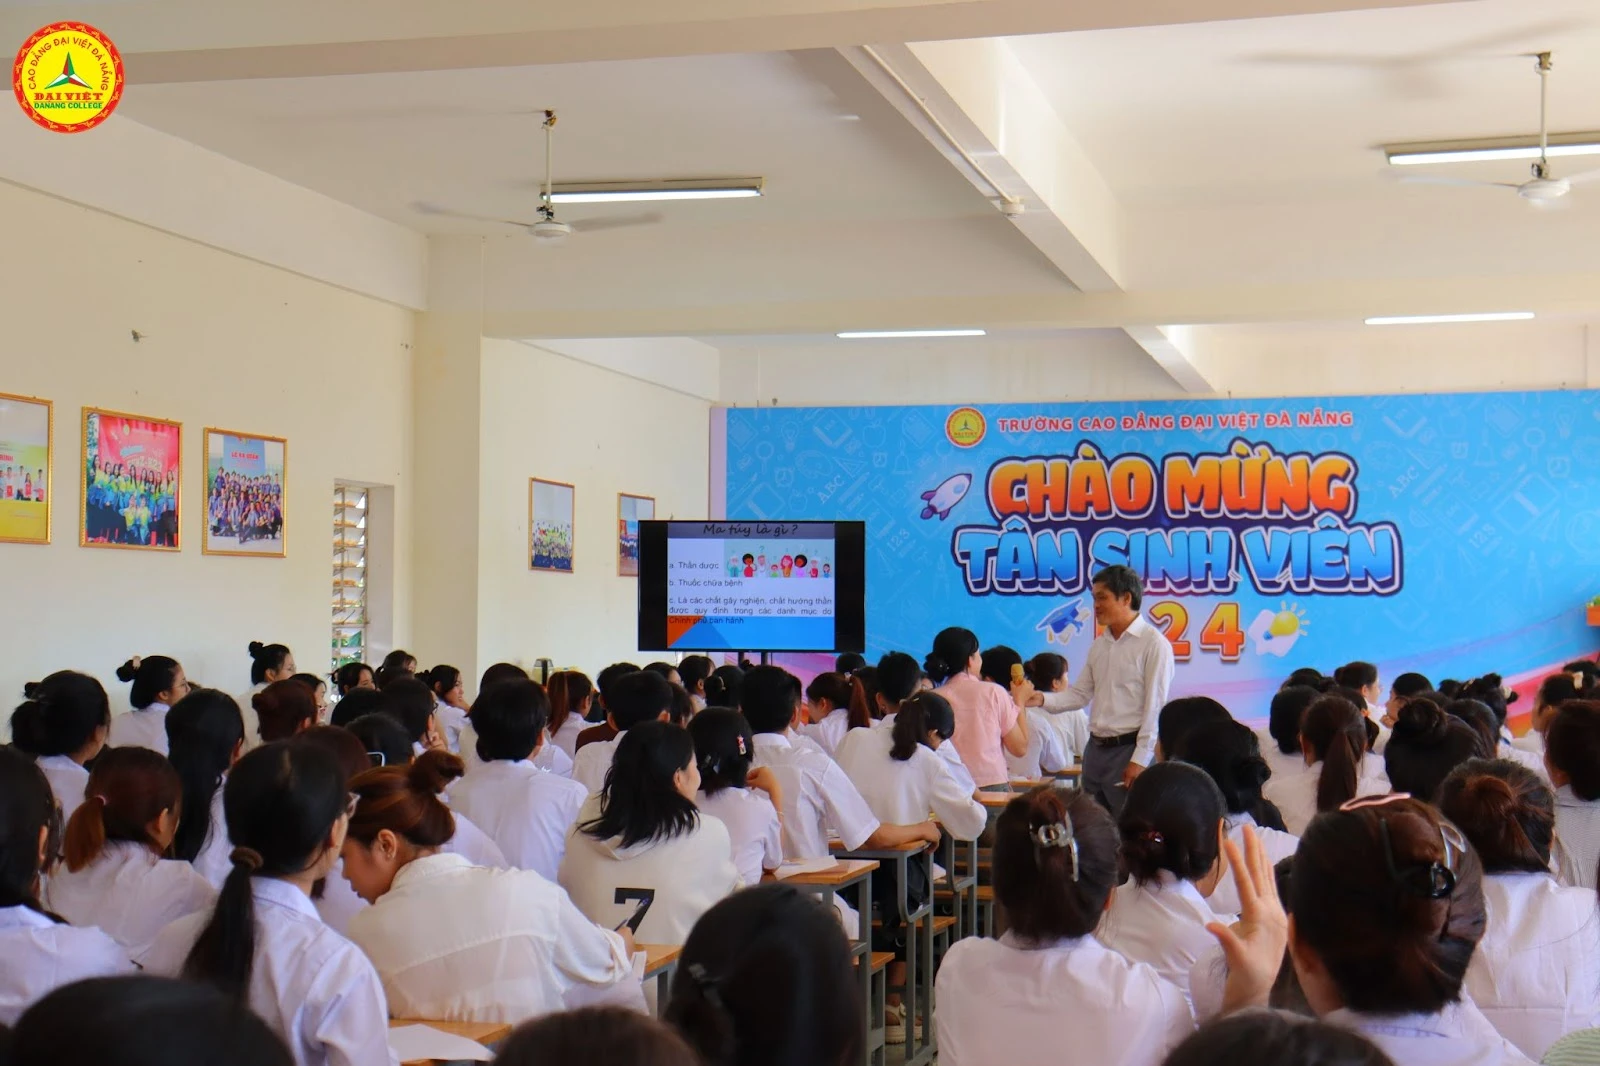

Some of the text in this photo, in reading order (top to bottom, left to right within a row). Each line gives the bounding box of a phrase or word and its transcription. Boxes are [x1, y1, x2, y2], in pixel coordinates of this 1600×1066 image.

[998, 415, 1073, 432] TRƯỜNG
[1078, 417, 1116, 431] CAO
[1122, 410, 1174, 430] ĐẲNG
[1180, 415, 1212, 432] ĐẠI
[1218, 411, 1259, 431] VIỆT
[1265, 410, 1292, 428] ĐÀ
[1298, 407, 1353, 427] NẴNG
[987, 440, 1357, 522] CHÀO MỪNG
[703, 523, 726, 535] Ma
[728, 523, 751, 537] túy
[756, 523, 772, 535] là
[954, 514, 1084, 593] TÂN
[1240, 511, 1401, 594] VIÊN
[678, 560, 697, 569] Thần
[679, 578, 702, 586] Thuốc
[725, 579, 743, 587] bệnh
[723, 597, 737, 605] gây
[694, 608, 708, 616] quy
[713, 606, 728, 615] định
[734, 607, 753, 616] trong
[758, 607, 772, 615] các
[777, 607, 796, 615] danh
[801, 608, 817, 616] mục
[822, 607, 832, 615] do
[614, 887, 655, 936] 7
